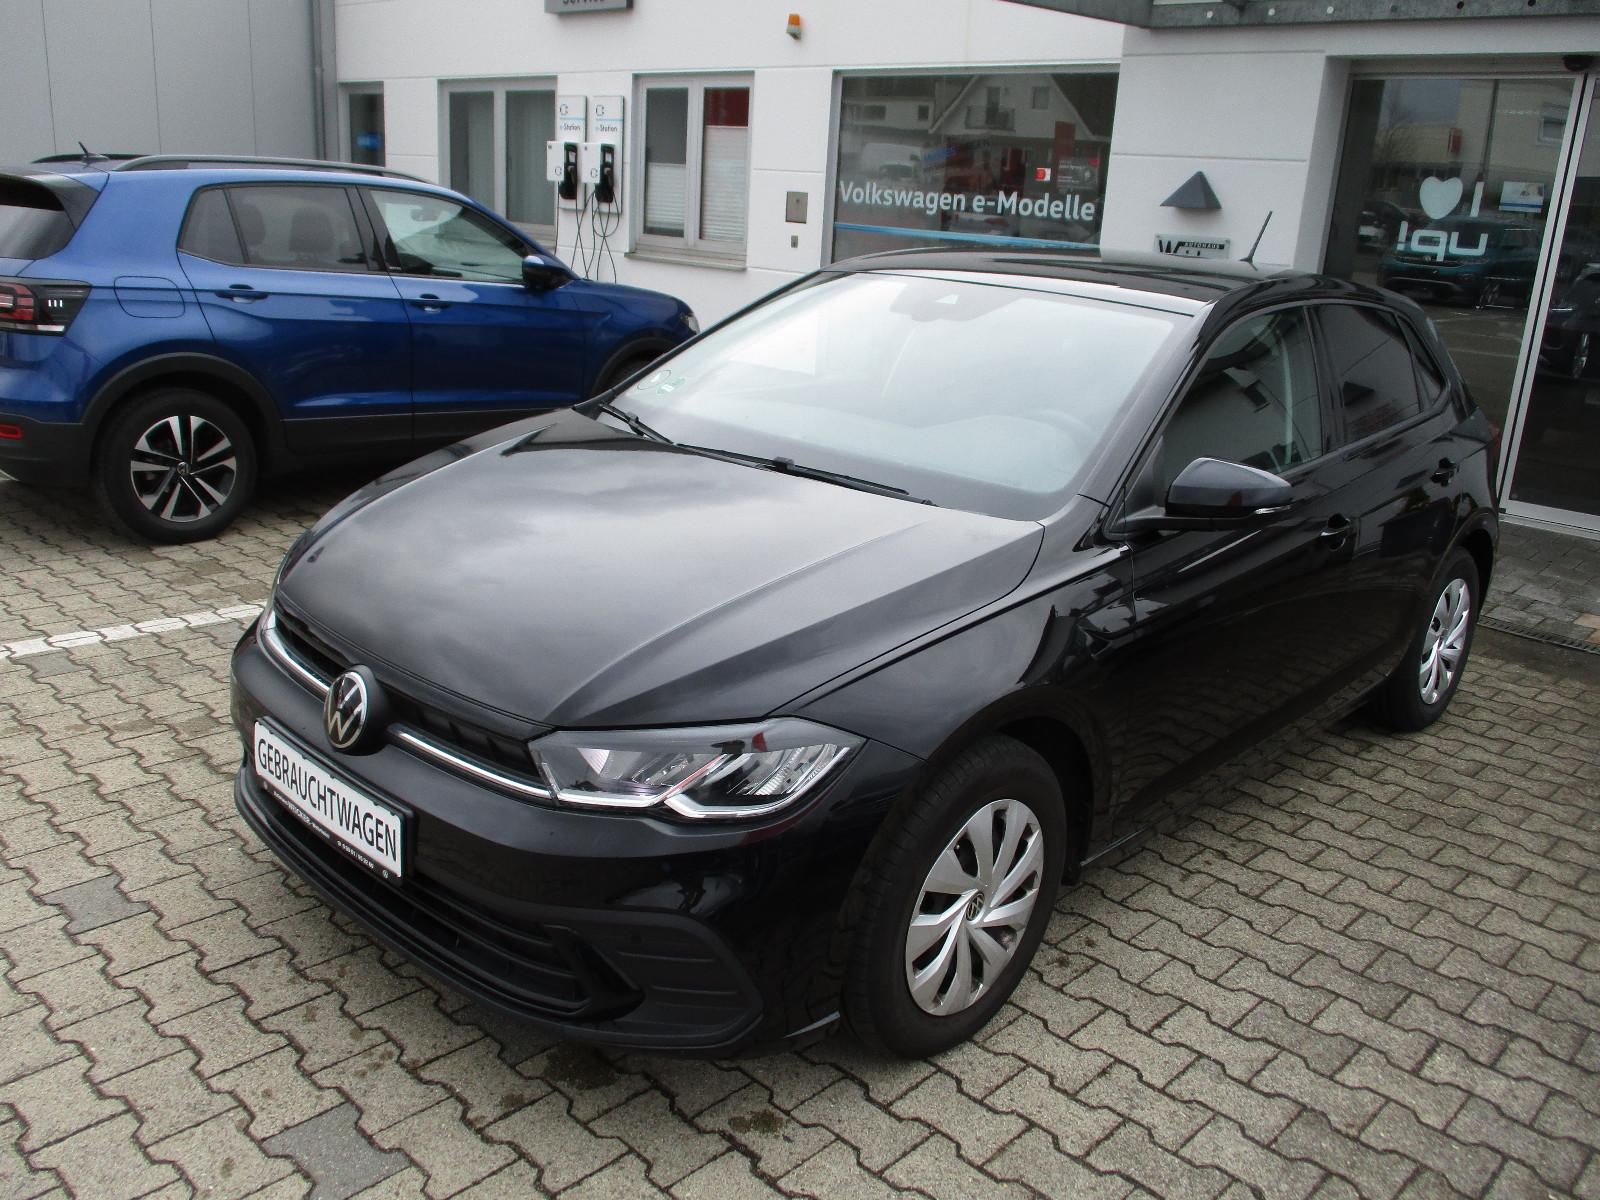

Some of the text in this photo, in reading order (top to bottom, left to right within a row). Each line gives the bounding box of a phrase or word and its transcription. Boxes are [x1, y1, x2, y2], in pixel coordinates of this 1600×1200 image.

[839, 180, 1096, 221] Volkswagen e-Modelle
[257, 738, 397, 862] GEBRAUCHTWAGEN
